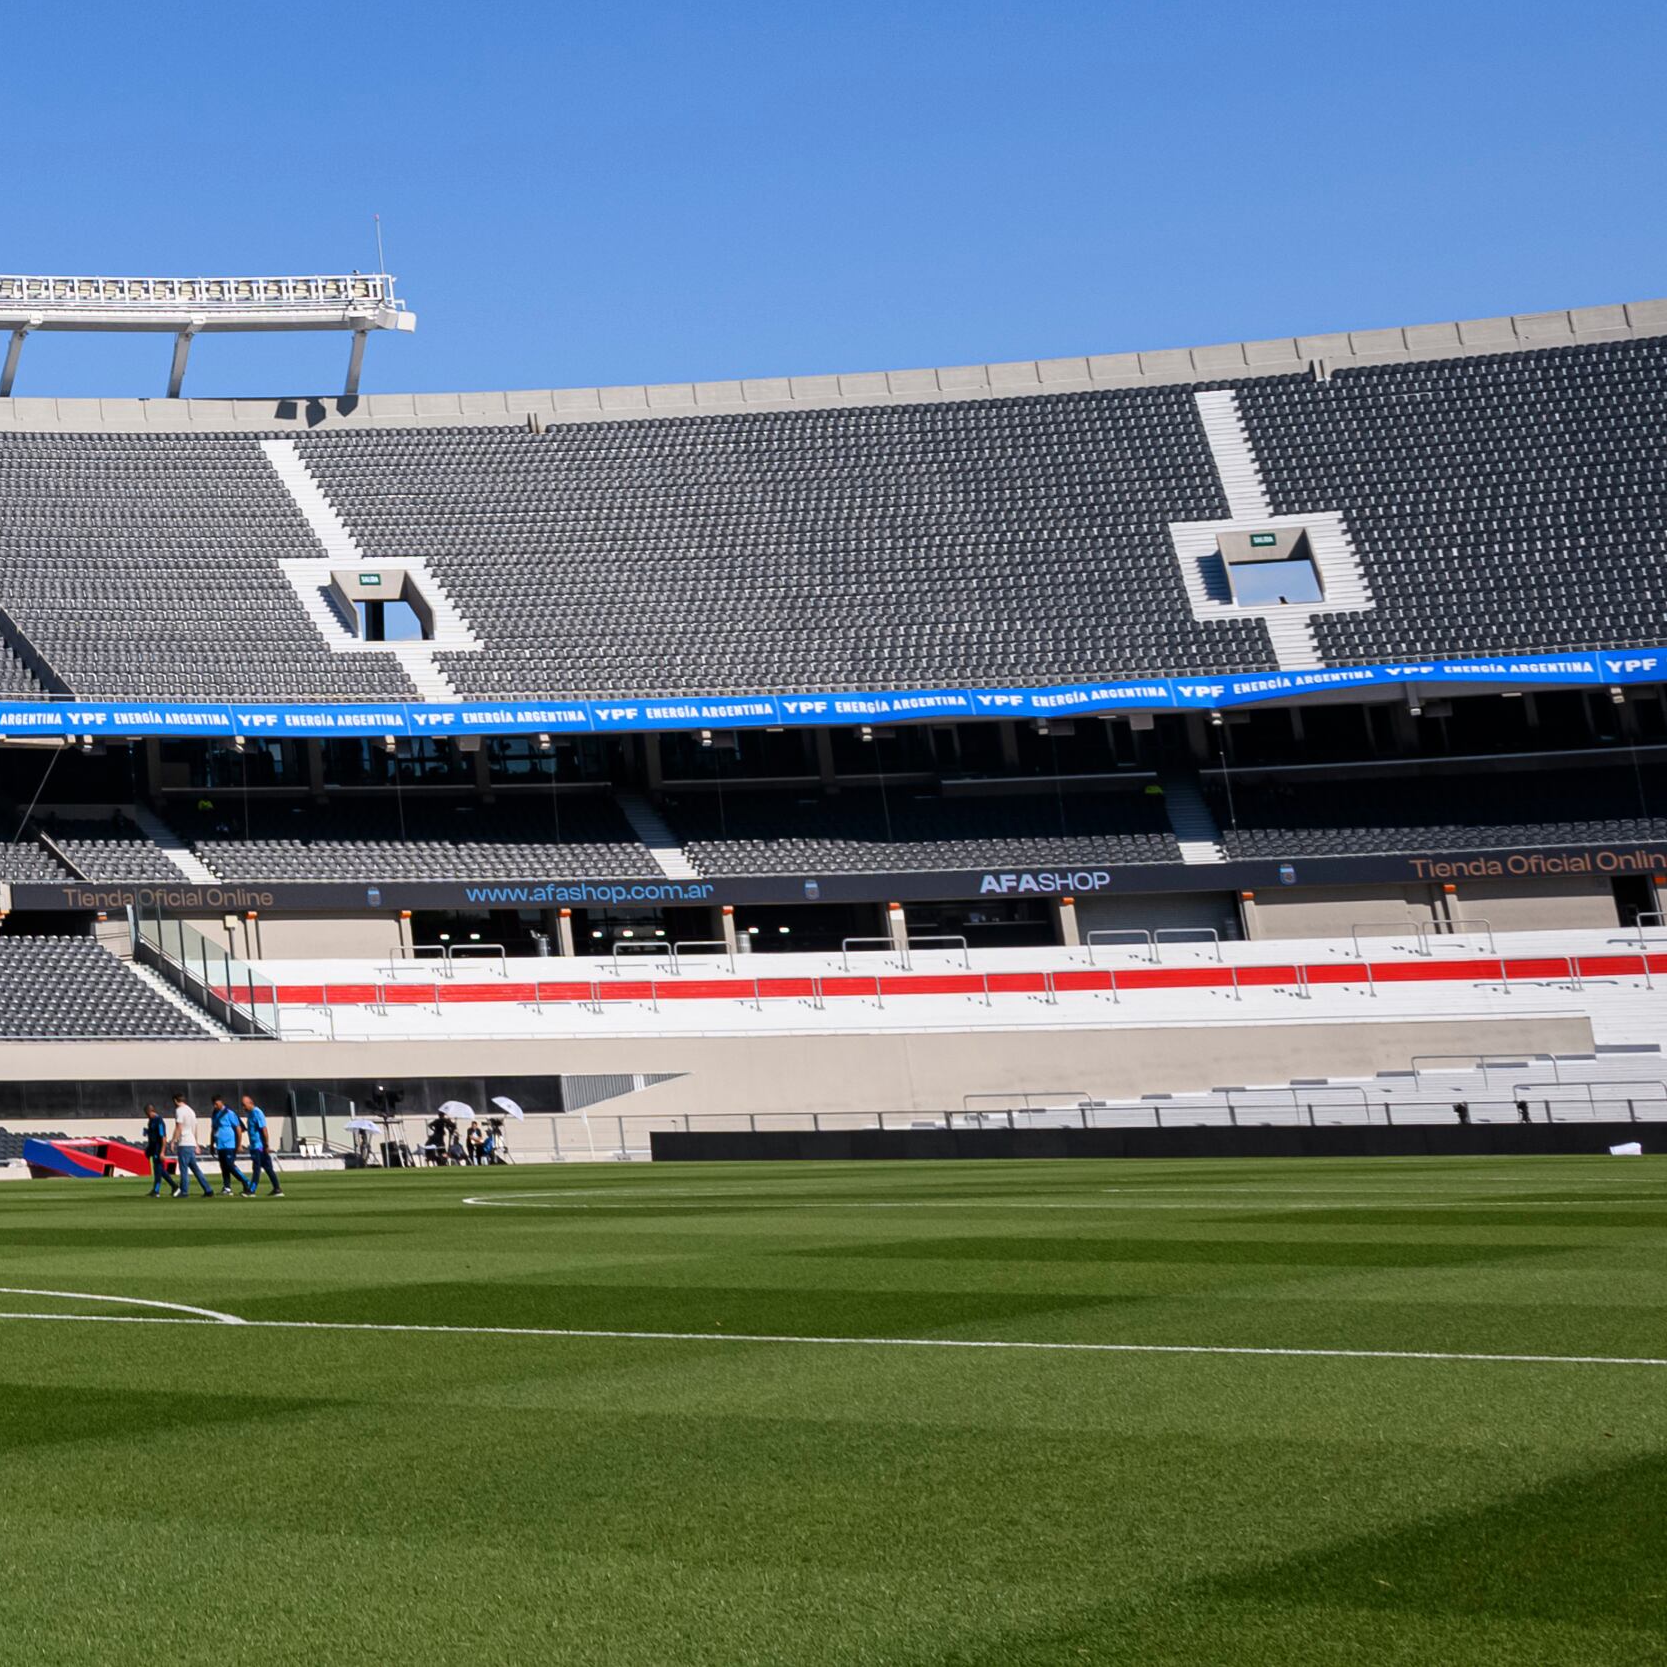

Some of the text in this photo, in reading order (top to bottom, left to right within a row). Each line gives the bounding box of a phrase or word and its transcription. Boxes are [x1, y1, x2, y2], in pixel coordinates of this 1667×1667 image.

[1509, 660, 1595, 674] ARGENTINA
[1604, 658, 1659, 675] YPF
[1177, 669, 1374, 700] YPF ENERGÍA ARGENTINA
[782, 694, 968, 714] YPF ENERGÍA ARGENTINA
[976, 686, 1169, 708] YPF ENERGÍA ARGENTINA
[0, 712, 64, 726] ARGENTINA
[66, 710, 231, 726] YPF ENERGÍA ARGENTINA
[237, 713, 405, 727] YPF ENERGÍA ARGENTINA
[412, 709, 588, 726] YPF ENERGÍA ARGENTINA
[594, 703, 775, 721] YPF ENERGÍA ARGENTINA
[1408, 857, 1504, 879] Tienda
[1507, 852, 1592, 875] Oficial
[979, 871, 1111, 894] AFASHOP
[62, 886, 274, 908] Tienda Oficial Online
[465, 883, 715, 904] www.afashop.com.ar
